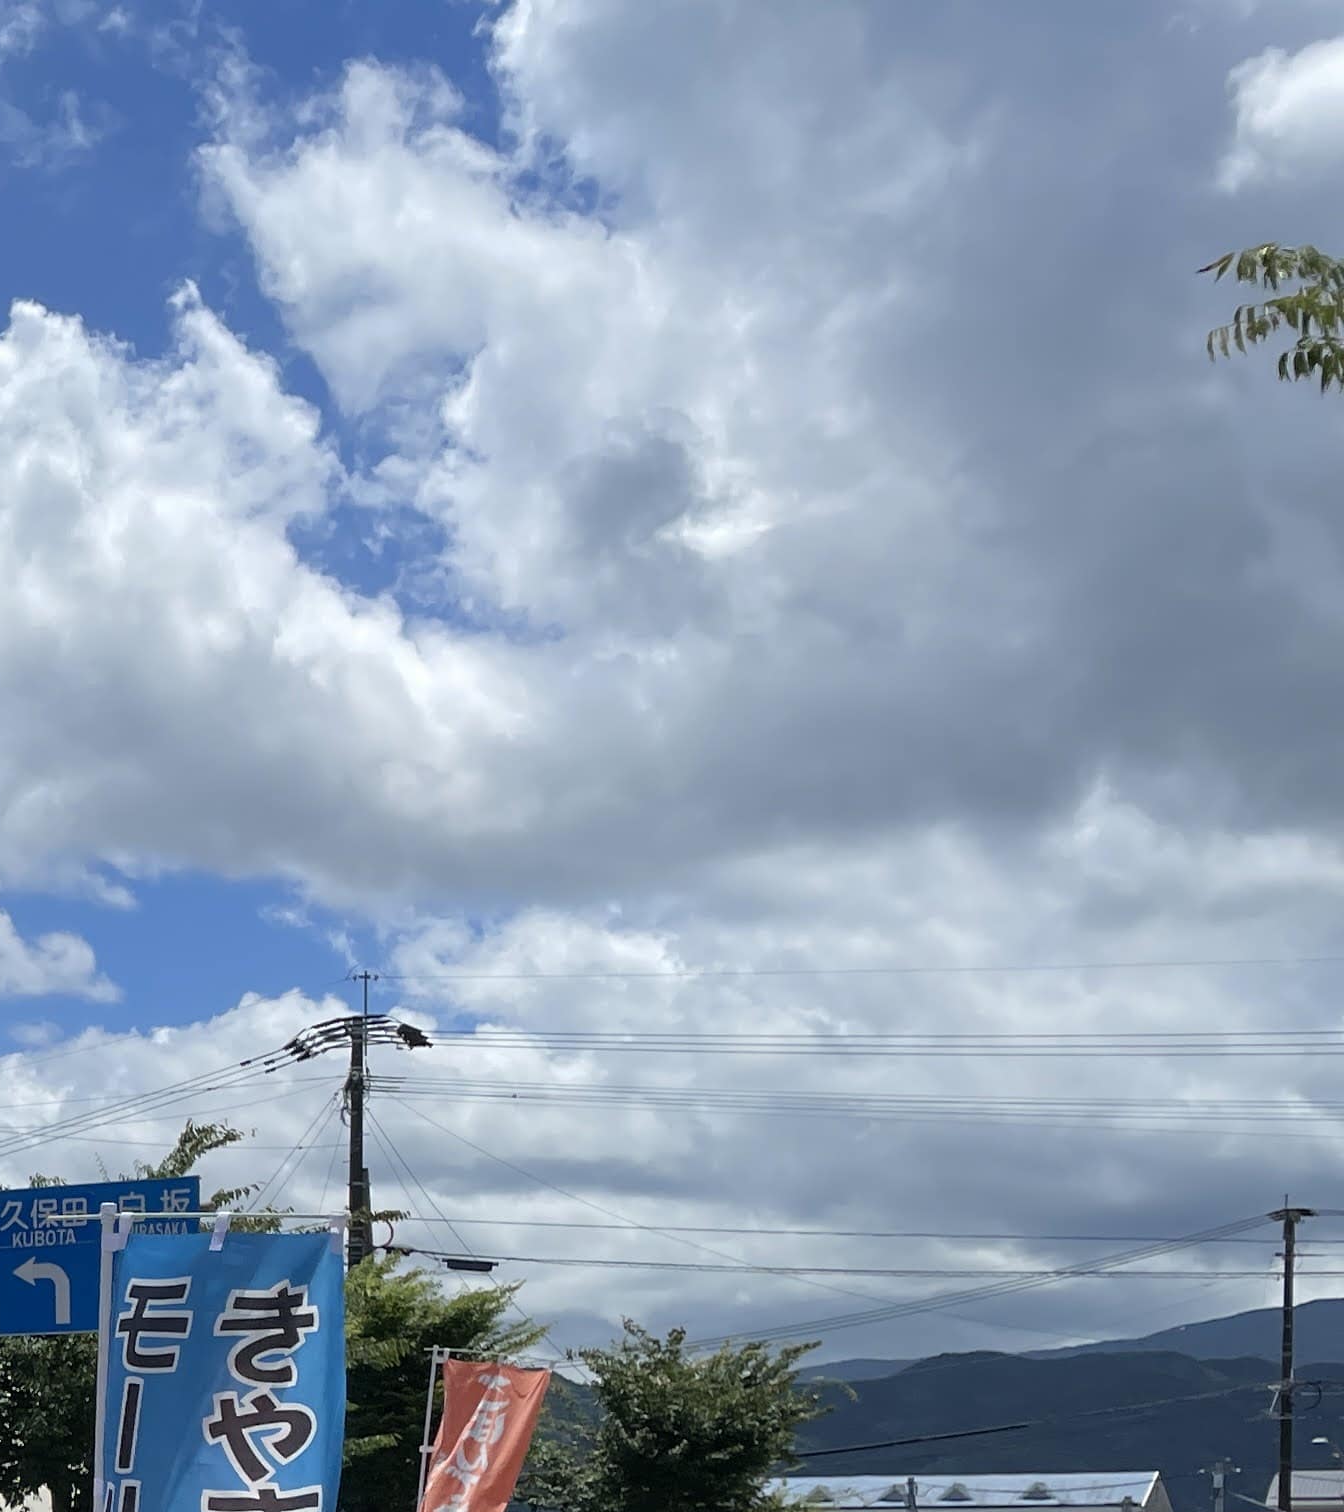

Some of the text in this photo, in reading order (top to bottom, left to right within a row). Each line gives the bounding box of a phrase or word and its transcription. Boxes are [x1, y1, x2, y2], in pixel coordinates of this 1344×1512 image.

[0, 1196, 88, 1232] 久保田
[12, 1228, 77, 1248] KUBOTA
